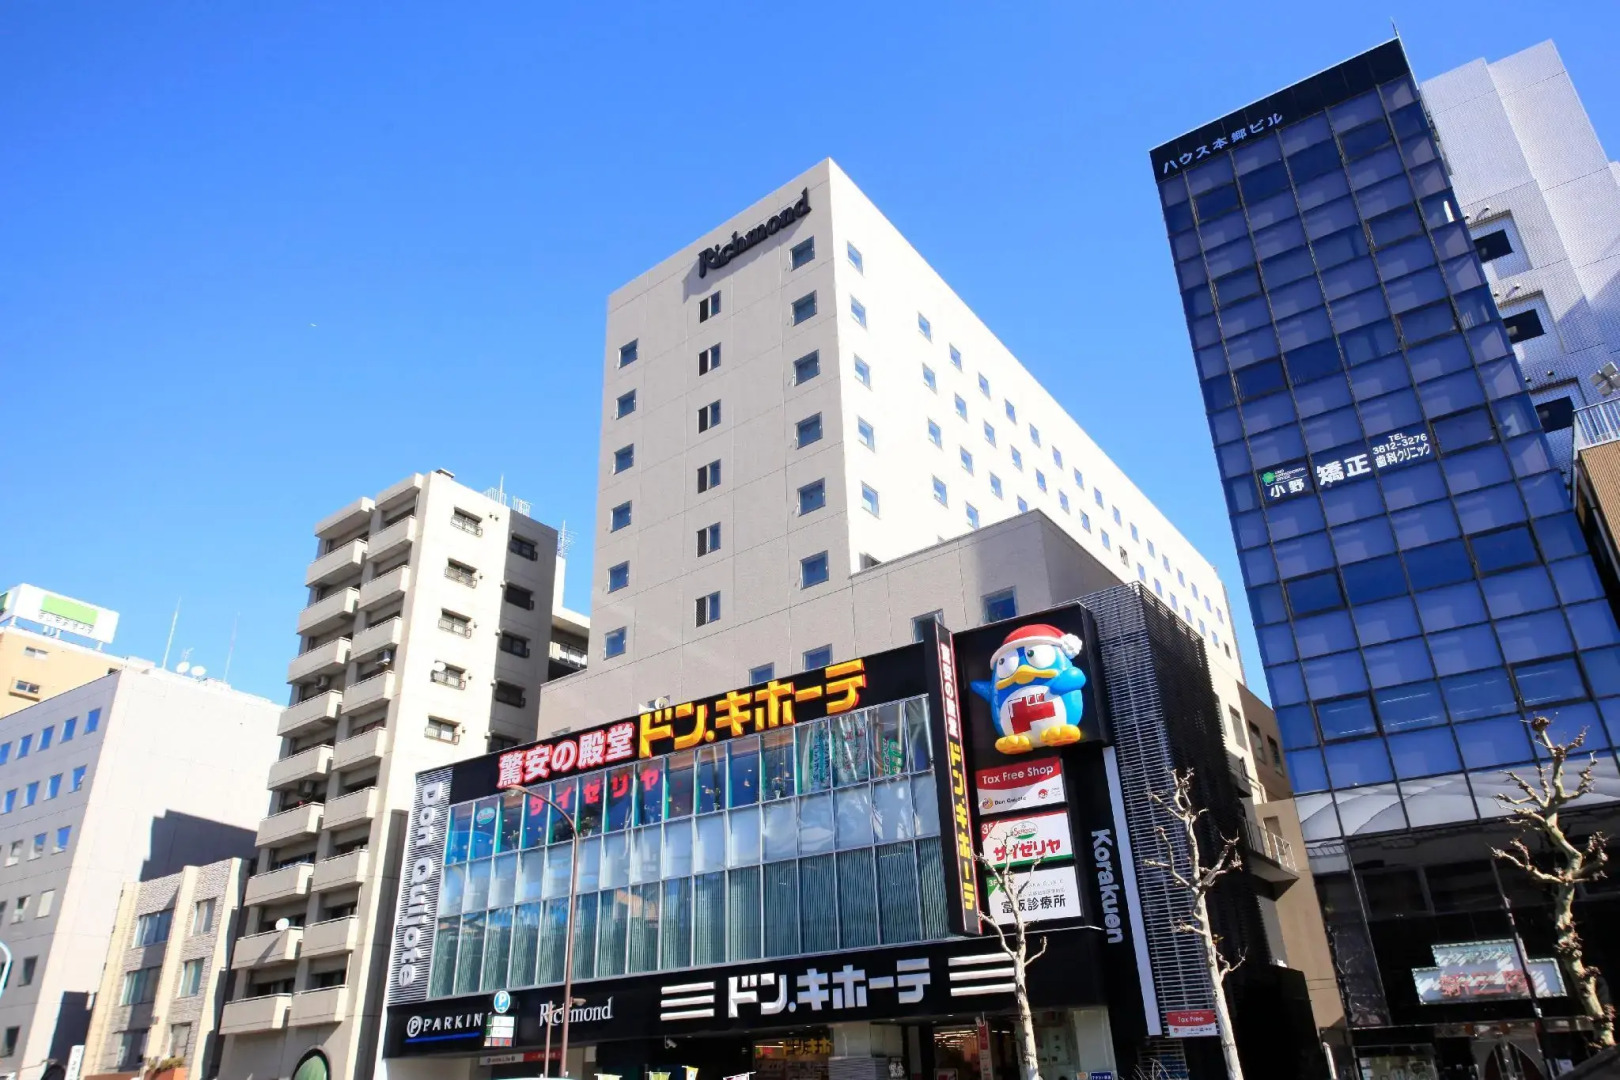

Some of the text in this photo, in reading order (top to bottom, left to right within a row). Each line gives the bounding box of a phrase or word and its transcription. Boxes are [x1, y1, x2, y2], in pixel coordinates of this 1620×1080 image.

[1163, 112, 1283, 175] ハウス本郷ビル
[698, 186, 812, 279] Richmond
[1373, 433, 1427, 455] 3812-3276
[1388, 433, 1407, 442] TEL
[496, 721, 636, 788] 驚安の殿堂
[982, 765, 1054, 785] Tax Free Shop
[414, 780, 445, 848] Don
[982, 822, 994, 835] 3F
[993, 838, 1061, 862] サイゼリヤ
[1091, 828, 1124, 944] Korakuen
[423, 1011, 491, 1032] PARKIN
[538, 995, 615, 1027] Rcmond
